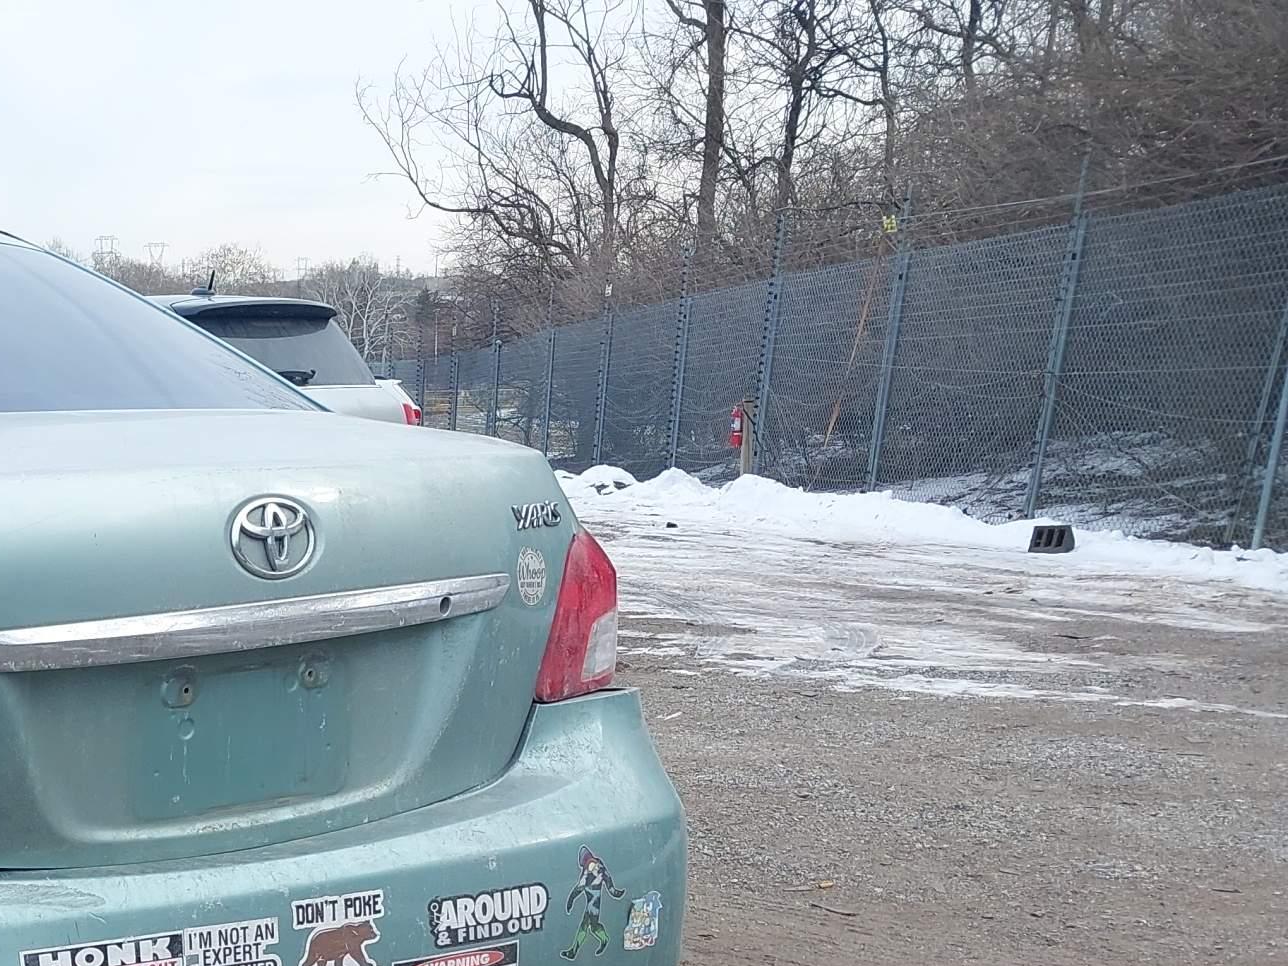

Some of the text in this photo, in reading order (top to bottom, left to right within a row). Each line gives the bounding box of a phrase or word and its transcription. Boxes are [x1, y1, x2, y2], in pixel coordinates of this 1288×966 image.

[295, 893, 382, 925] DON'T POKE
[438, 885, 547, 931] AROUND
[188, 922, 275, 951] I'M NOT AN
[436, 914, 543, 946] & FIND OUT
[204, 943, 262, 966] EXPERT
